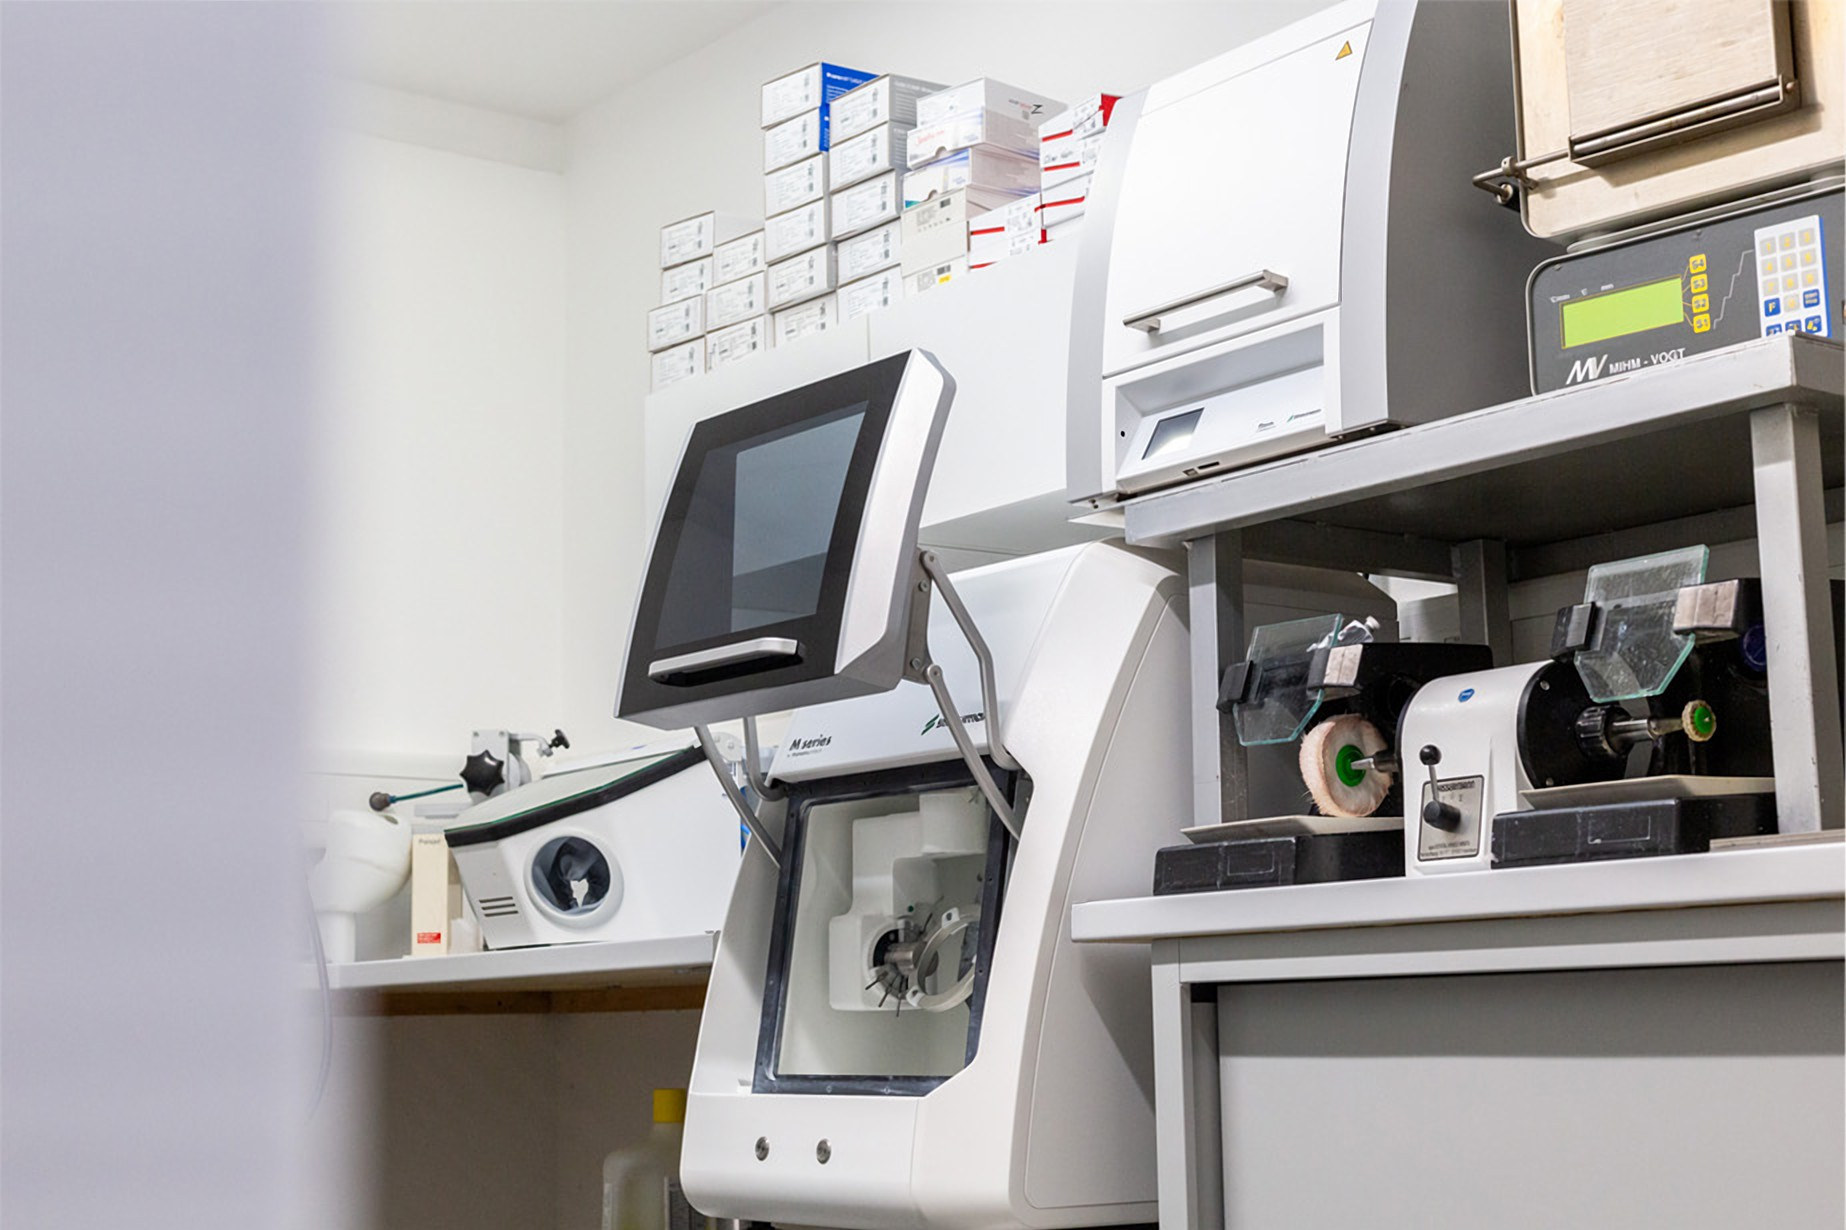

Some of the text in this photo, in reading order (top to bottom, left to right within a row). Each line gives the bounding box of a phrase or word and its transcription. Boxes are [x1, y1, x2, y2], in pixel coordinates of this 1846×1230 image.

[1609, 358, 1641, 374] MIHM
[1650, 347, 1686, 365] VOGT
[789, 734, 832, 751] M series
